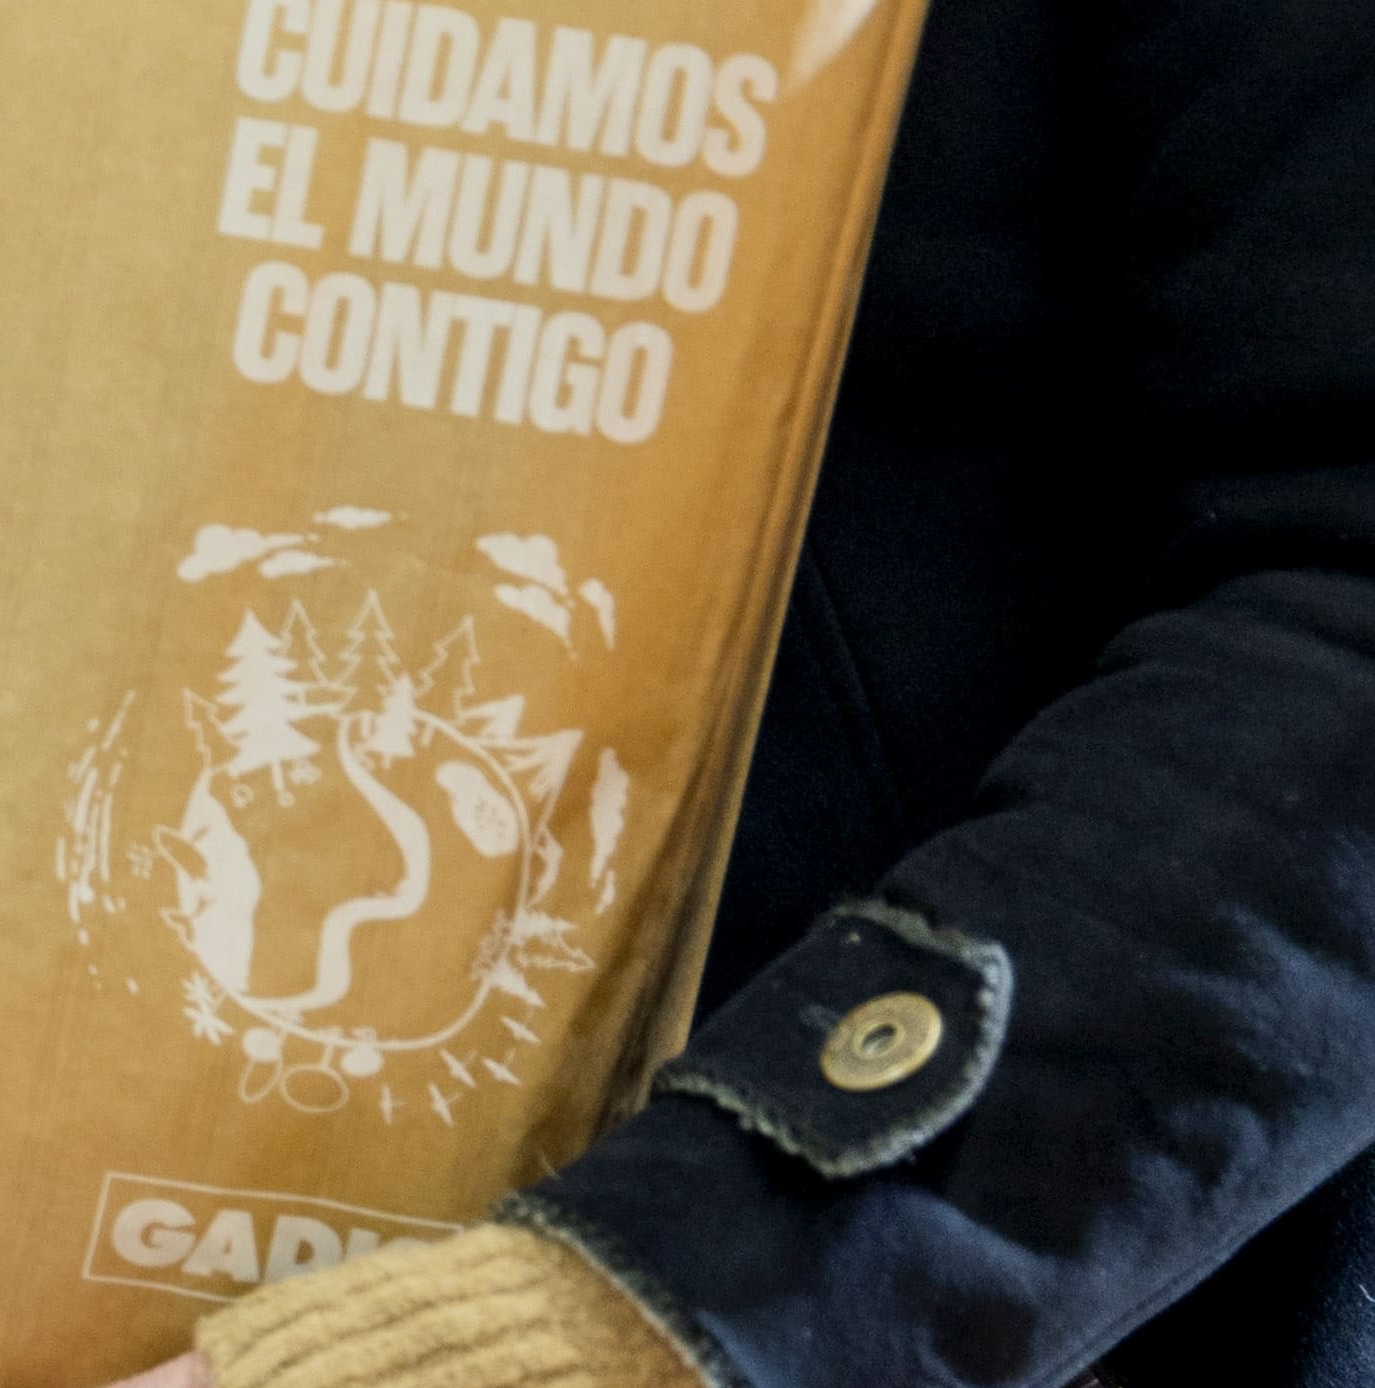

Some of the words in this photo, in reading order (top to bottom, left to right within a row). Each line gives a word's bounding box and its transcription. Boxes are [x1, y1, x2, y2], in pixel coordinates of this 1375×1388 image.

[235, 0, 778, 177] CUIDAMOS
[218, 117, 324, 250] EL
[349, 138, 739, 313] MUNDO
[232, 261, 674, 445] CONTIGO
